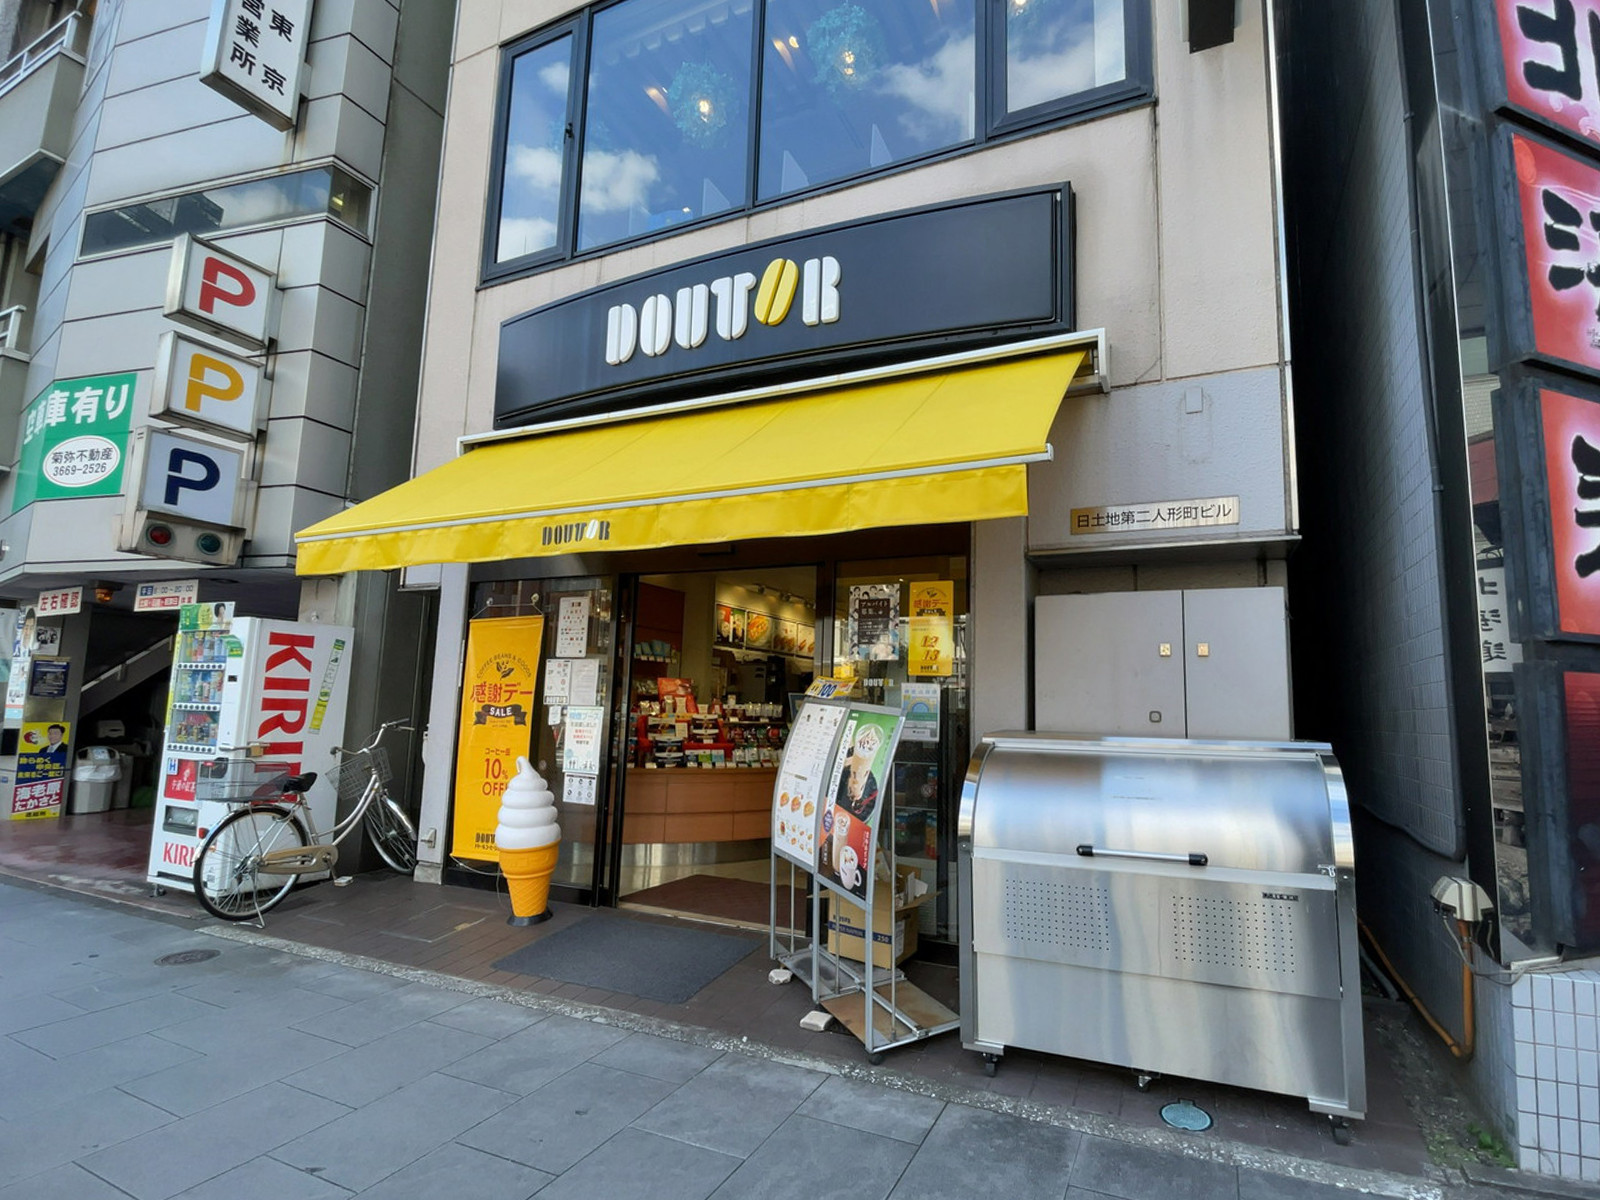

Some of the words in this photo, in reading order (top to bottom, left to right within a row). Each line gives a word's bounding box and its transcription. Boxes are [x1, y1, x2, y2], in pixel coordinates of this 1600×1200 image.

[229, 0, 265, 76] 営業所
[262, 8, 295, 96] 東京
[199, 256, 256, 314] P
[605, 256, 842, 366] DOUTOR
[185, 353, 245, 412] P
[51, 447, 114, 464] 菊弥不動産
[53, 462, 107, 477] 3669-2526
[164, 447, 221, 506] P
[1077, 503, 1232, 528] 日土地第二人形町ビル
[542, 519, 611, 546] DOUTOR
[470, 681, 533, 703] 感謝デー
[863, 678, 895, 687] DOUTOR
[489, 706, 513, 717] SALE
[484, 758, 509, 780] 10%
[14, 795, 61, 812] たかさと
[475, 832, 496, 844] DOUT
[163, 841, 197, 867] KIRI
